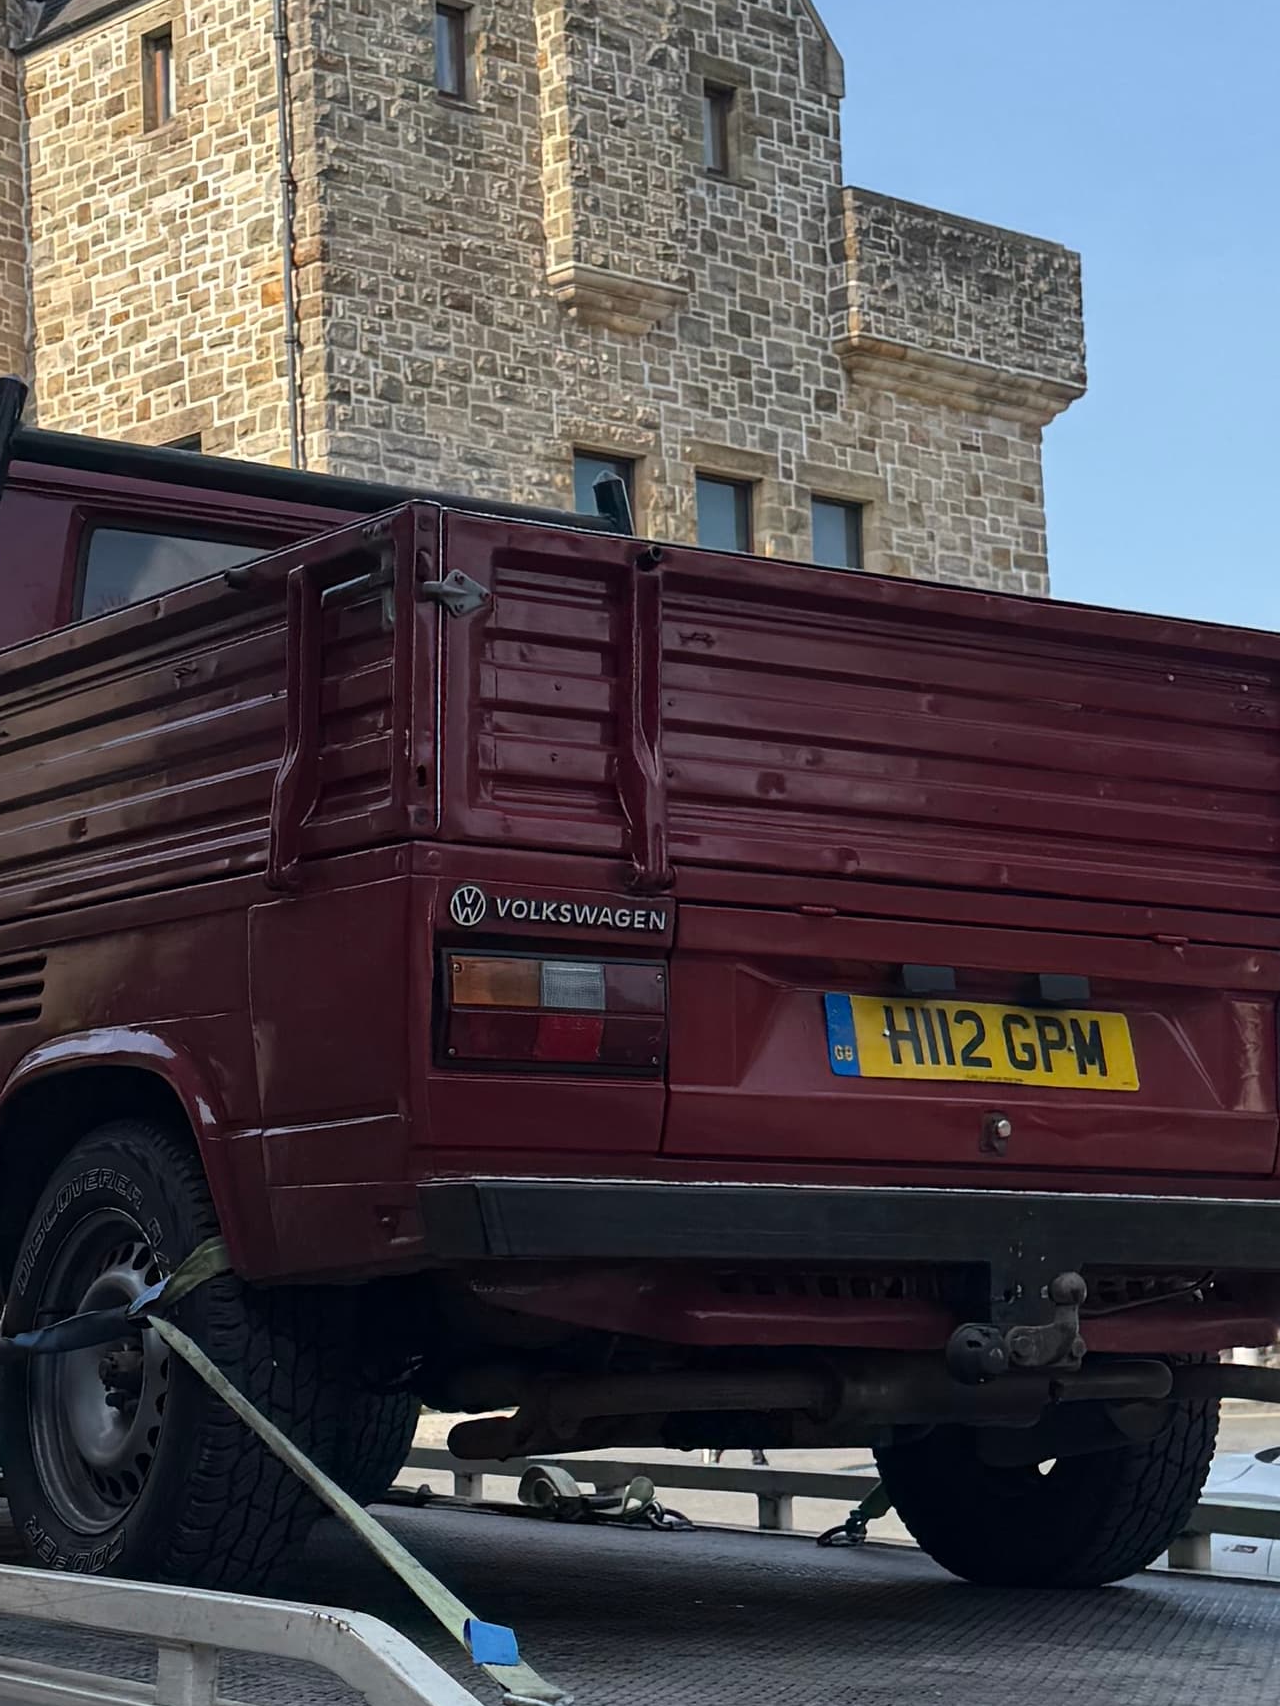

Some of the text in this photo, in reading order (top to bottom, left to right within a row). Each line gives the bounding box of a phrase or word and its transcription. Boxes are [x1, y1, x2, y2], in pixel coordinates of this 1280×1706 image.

[495, 897, 666, 930] VOLKSWAGEN
[833, 1044, 854, 1063] GB
[883, 1004, 1108, 1077] H112 GPM
[16, 1167, 145, 1297] DISCOVERER
